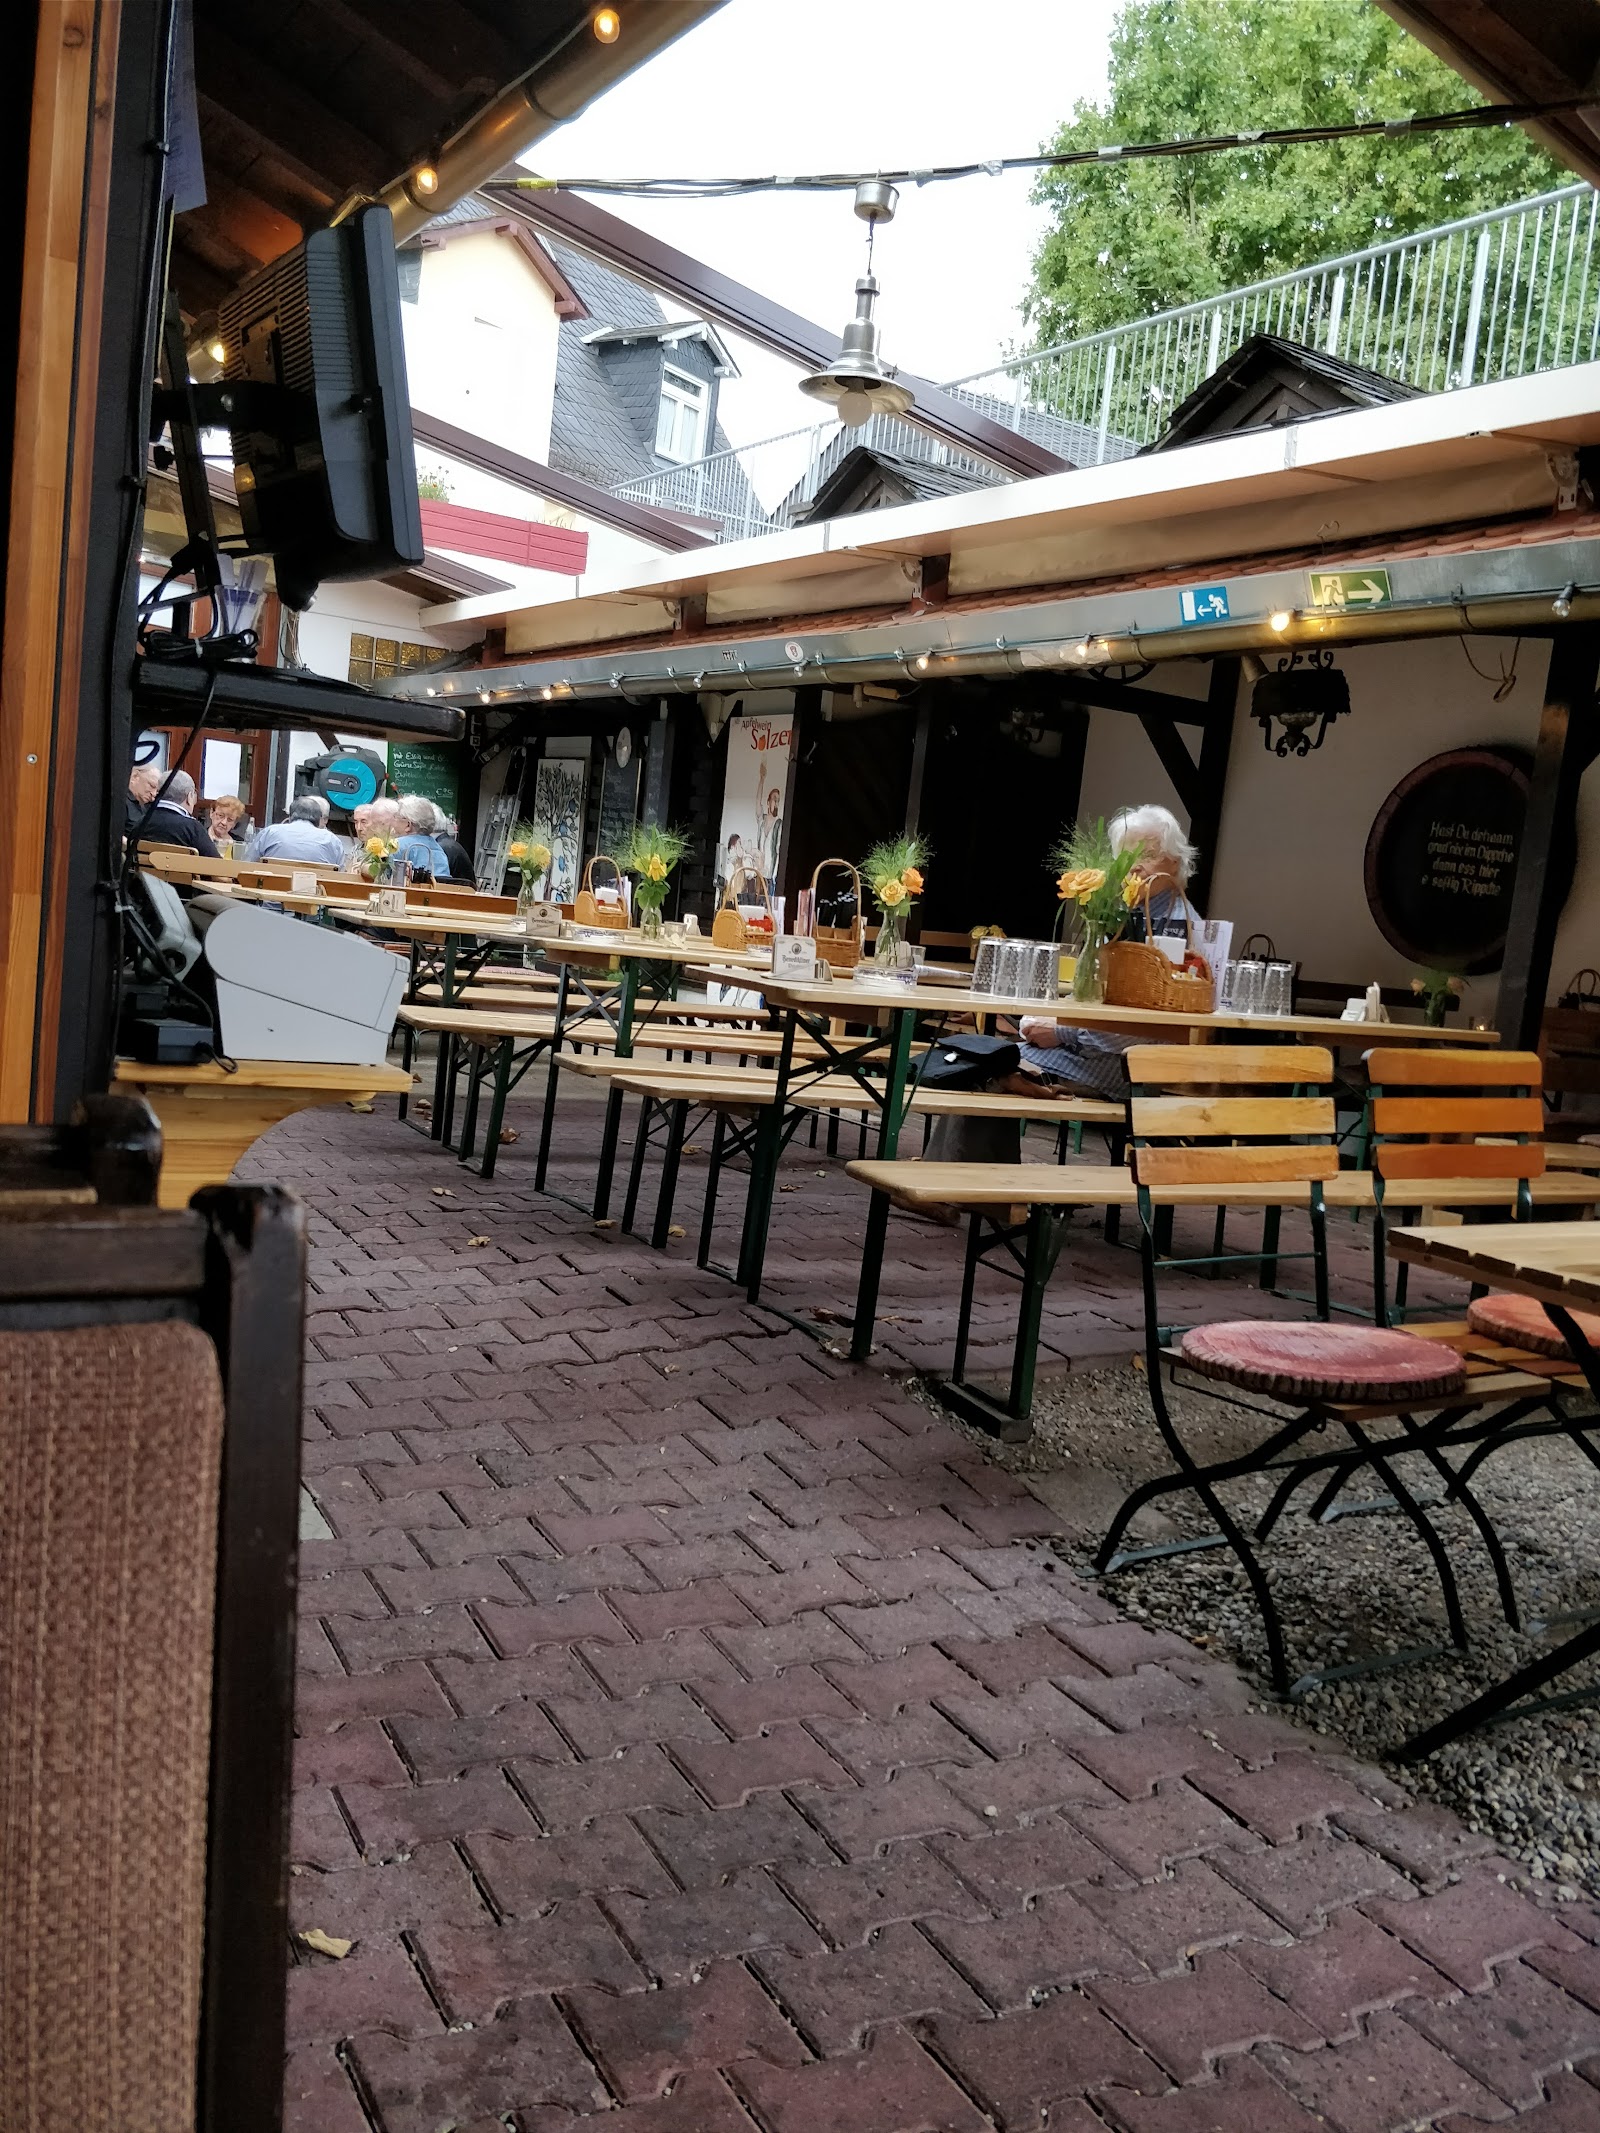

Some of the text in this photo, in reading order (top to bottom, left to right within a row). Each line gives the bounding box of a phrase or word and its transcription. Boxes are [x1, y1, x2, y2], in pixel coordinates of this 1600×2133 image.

[741, 717, 772, 732] Apfelwein
[1430, 821, 1455, 838] Hast
[1456, 823, 1470, 840] Du
[1432, 857, 1500, 878] dann ess hier
[1431, 876, 1460, 893] saftig
[1461, 878, 1501, 896] Rippche
